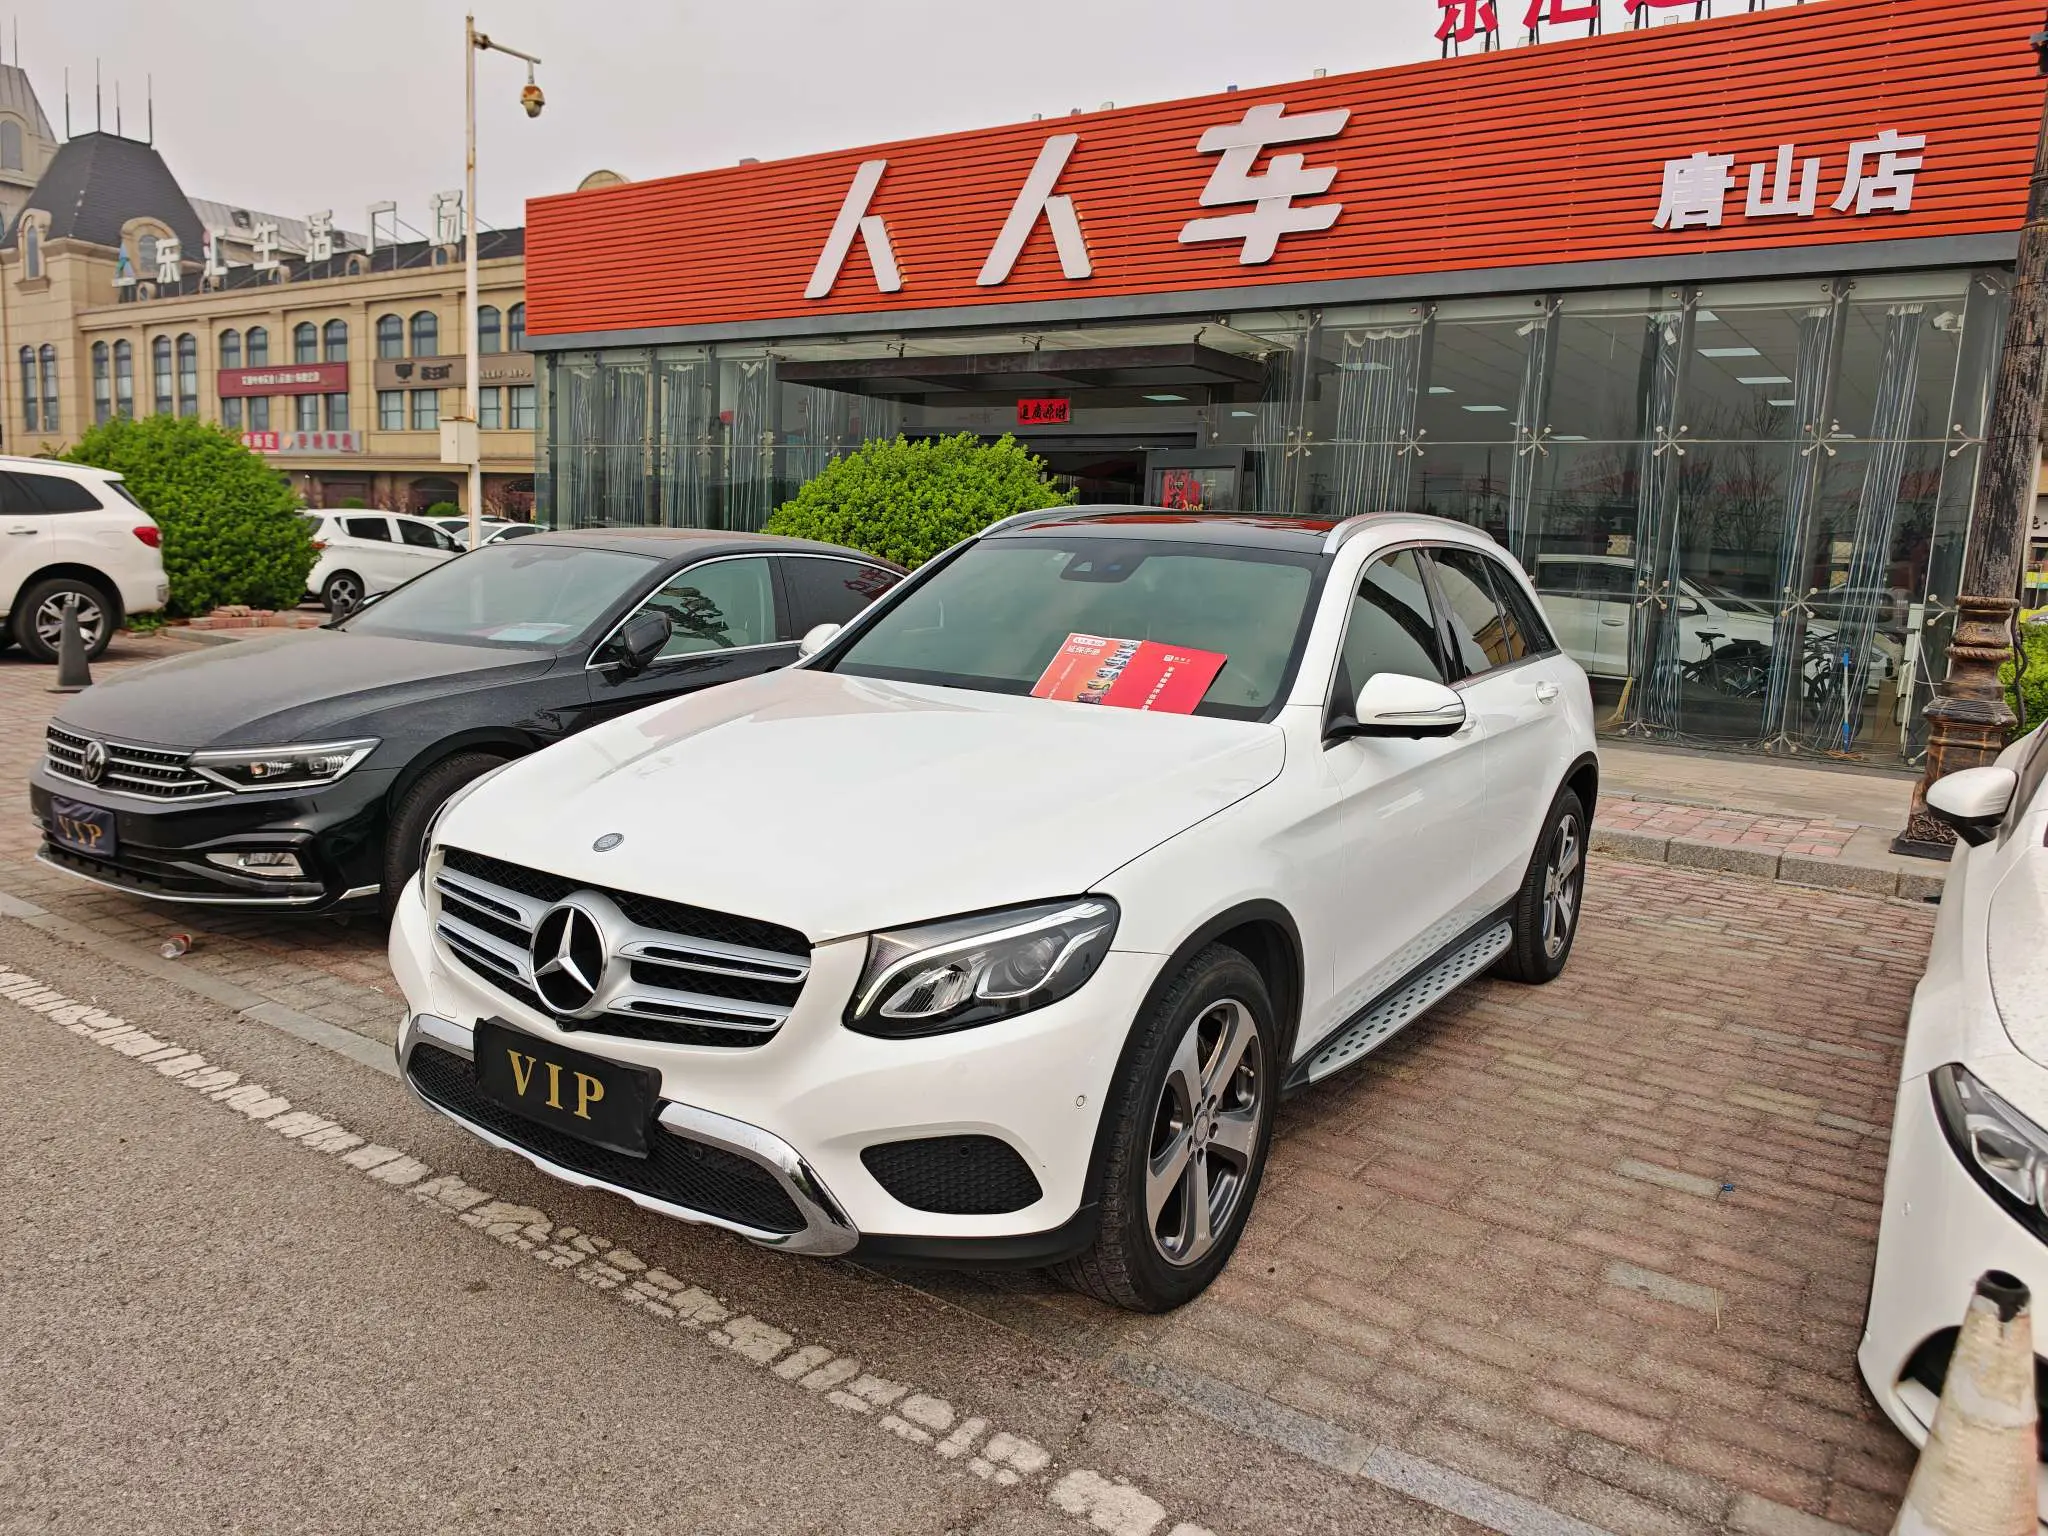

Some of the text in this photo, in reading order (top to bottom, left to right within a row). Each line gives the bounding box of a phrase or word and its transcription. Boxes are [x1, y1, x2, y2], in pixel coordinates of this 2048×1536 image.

[804, 102, 1352, 299] 人人车
[1652, 129, 1926, 229] 唐山店
[156, 190, 462, 284] 东汇生活广场
[58, 815, 103, 848] VIP
[507, 1048, 604, 1121] VIP
